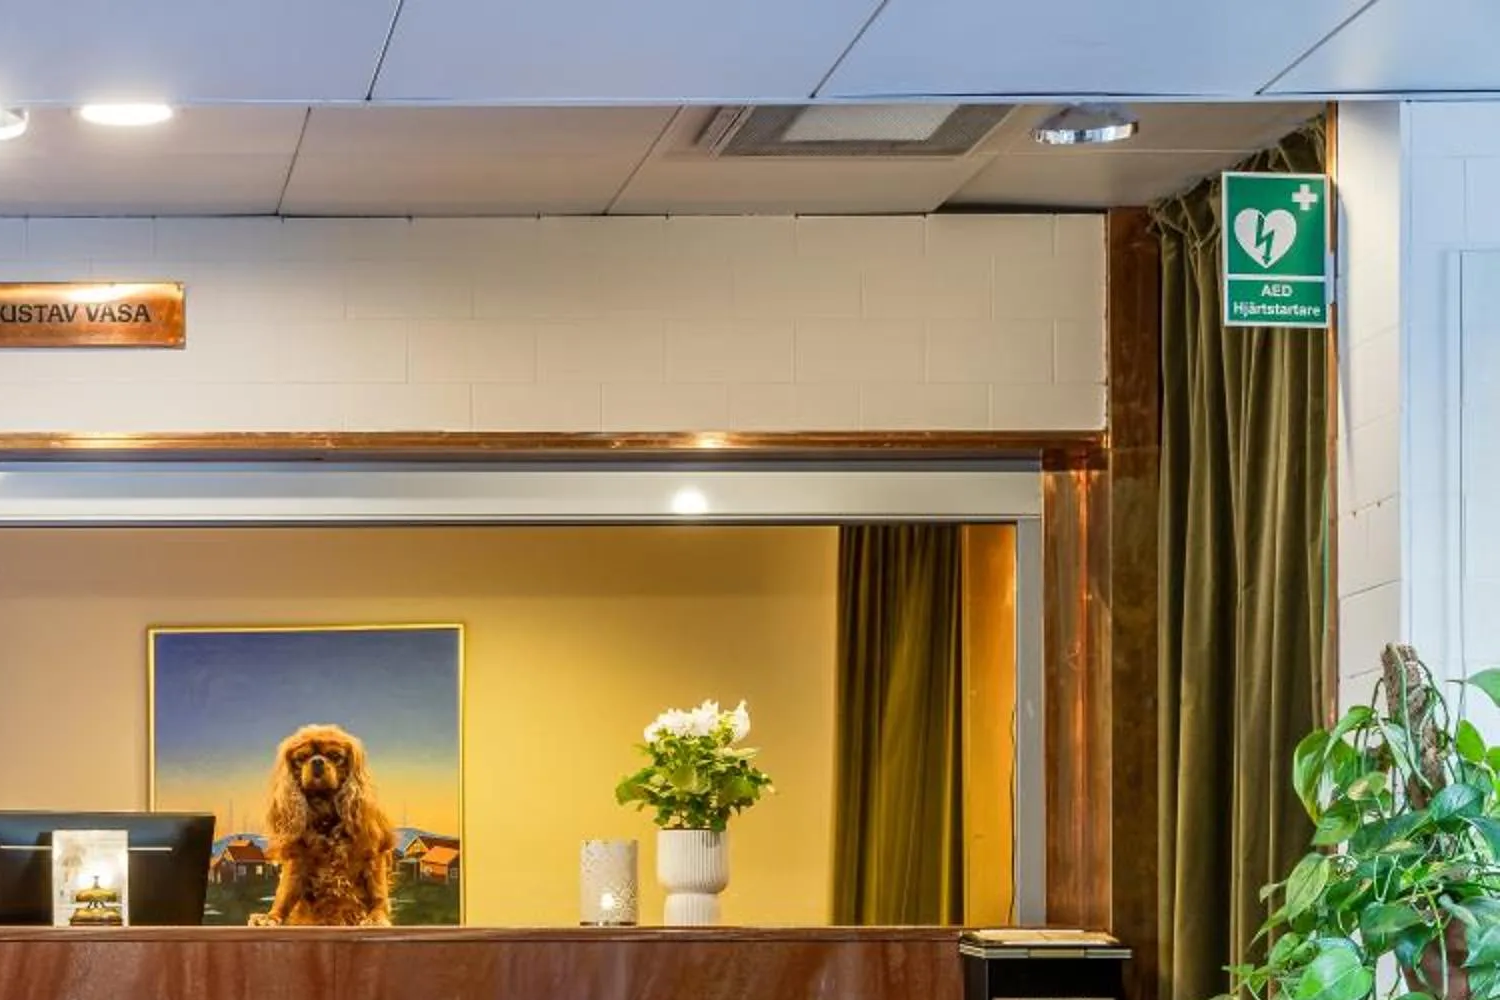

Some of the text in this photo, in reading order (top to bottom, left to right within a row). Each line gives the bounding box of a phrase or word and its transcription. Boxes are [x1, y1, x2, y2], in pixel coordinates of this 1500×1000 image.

[1261, 284, 1293, 297] AED
[84, 303, 152, 323] VASA
[1233, 302, 1320, 316] Hjärtstartare
